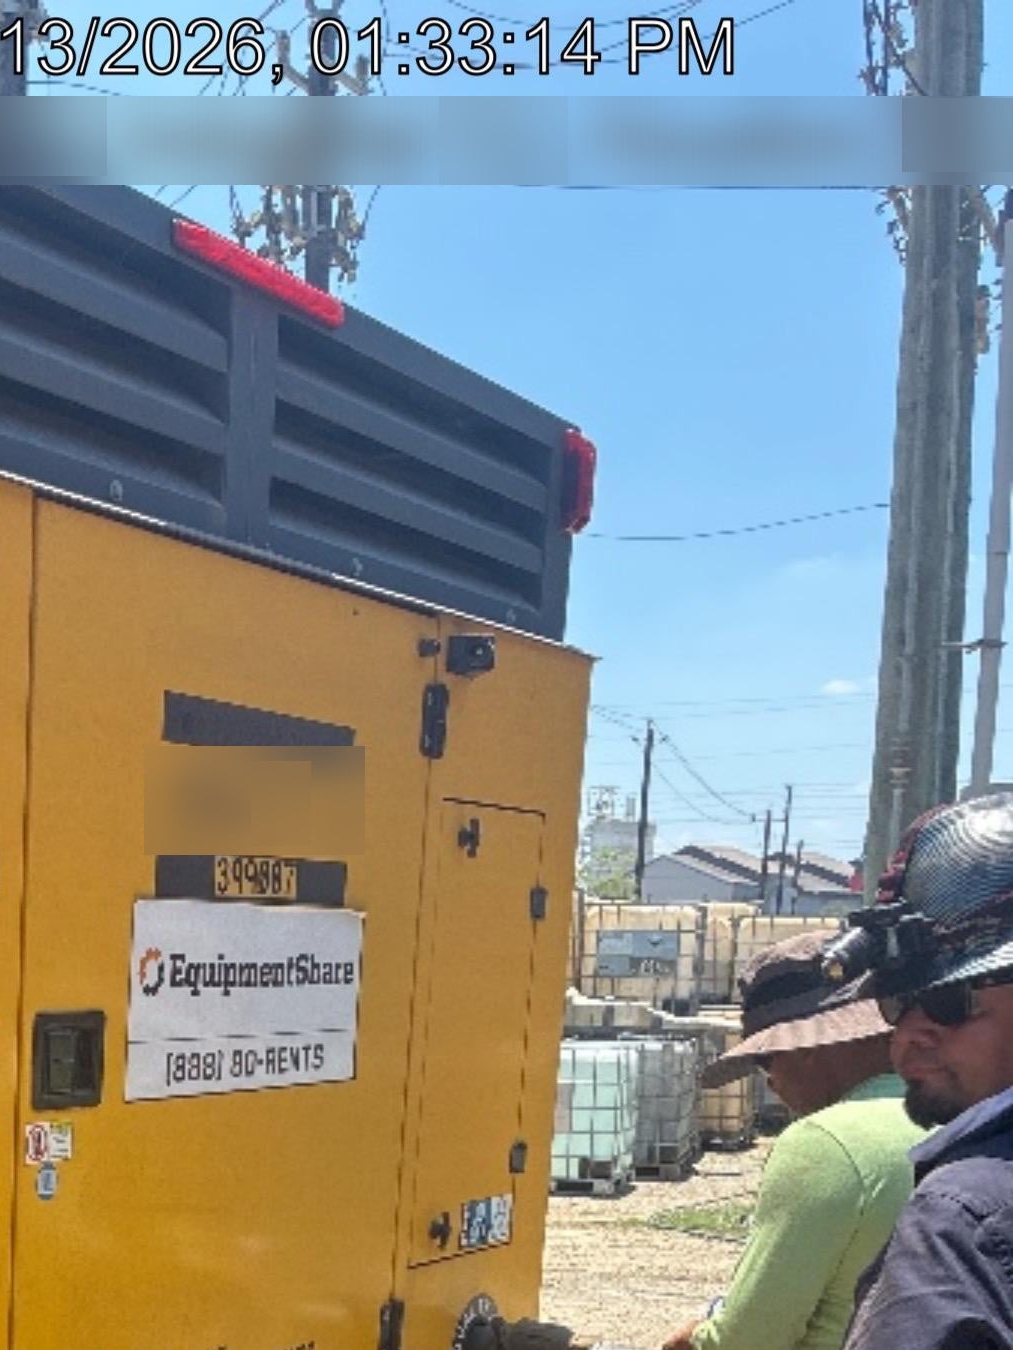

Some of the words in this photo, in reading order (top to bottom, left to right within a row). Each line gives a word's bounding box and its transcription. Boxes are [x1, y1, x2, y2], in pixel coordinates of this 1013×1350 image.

[169, 953, 355, 997] EquipmentShare
[166, 1049, 224, 1087] (888)
[229, 1043, 325, 1079] 80-RENTS
